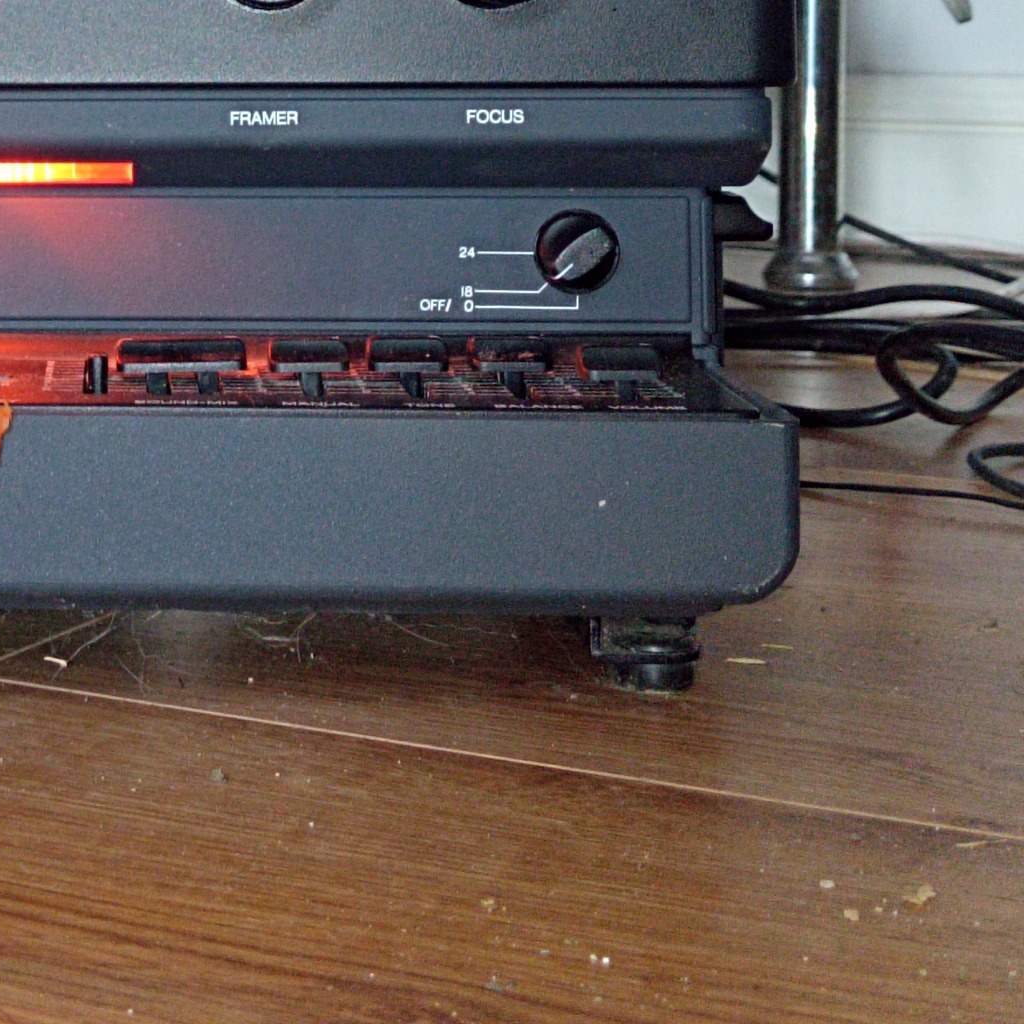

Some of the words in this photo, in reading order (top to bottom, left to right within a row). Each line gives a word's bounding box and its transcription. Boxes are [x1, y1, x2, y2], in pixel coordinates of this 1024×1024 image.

[229, 110, 299, 126] FRAMER
[465, 109, 525, 124] FOCUS
[458, 246, 476, 259] 24
[460, 285, 473, 298] 18
[419, 298, 452, 313] OFF/
